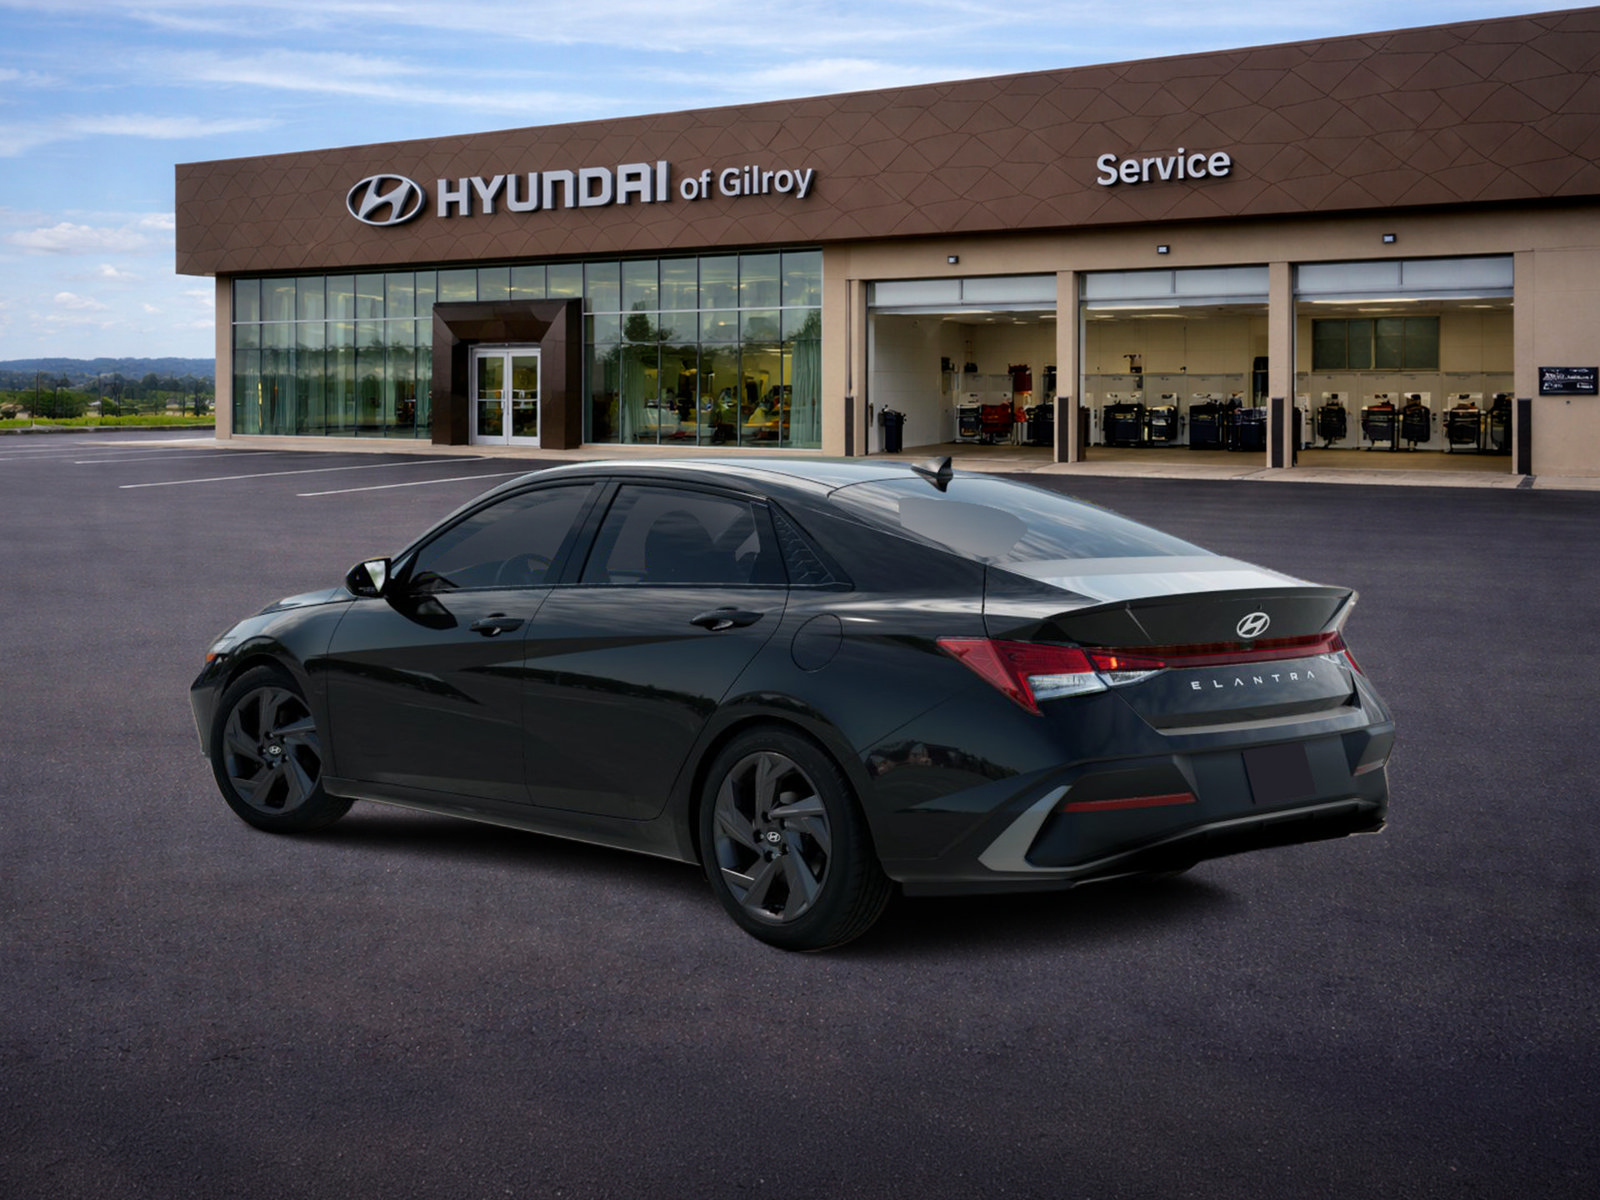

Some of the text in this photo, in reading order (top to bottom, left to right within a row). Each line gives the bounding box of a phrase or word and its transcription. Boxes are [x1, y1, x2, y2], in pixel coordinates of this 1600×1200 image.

[1096, 147, 1232, 186] Service
[437, 160, 813, 218] HYUNDAI of Gilroy
[1190, 670, 1316, 690] ELANTRA
